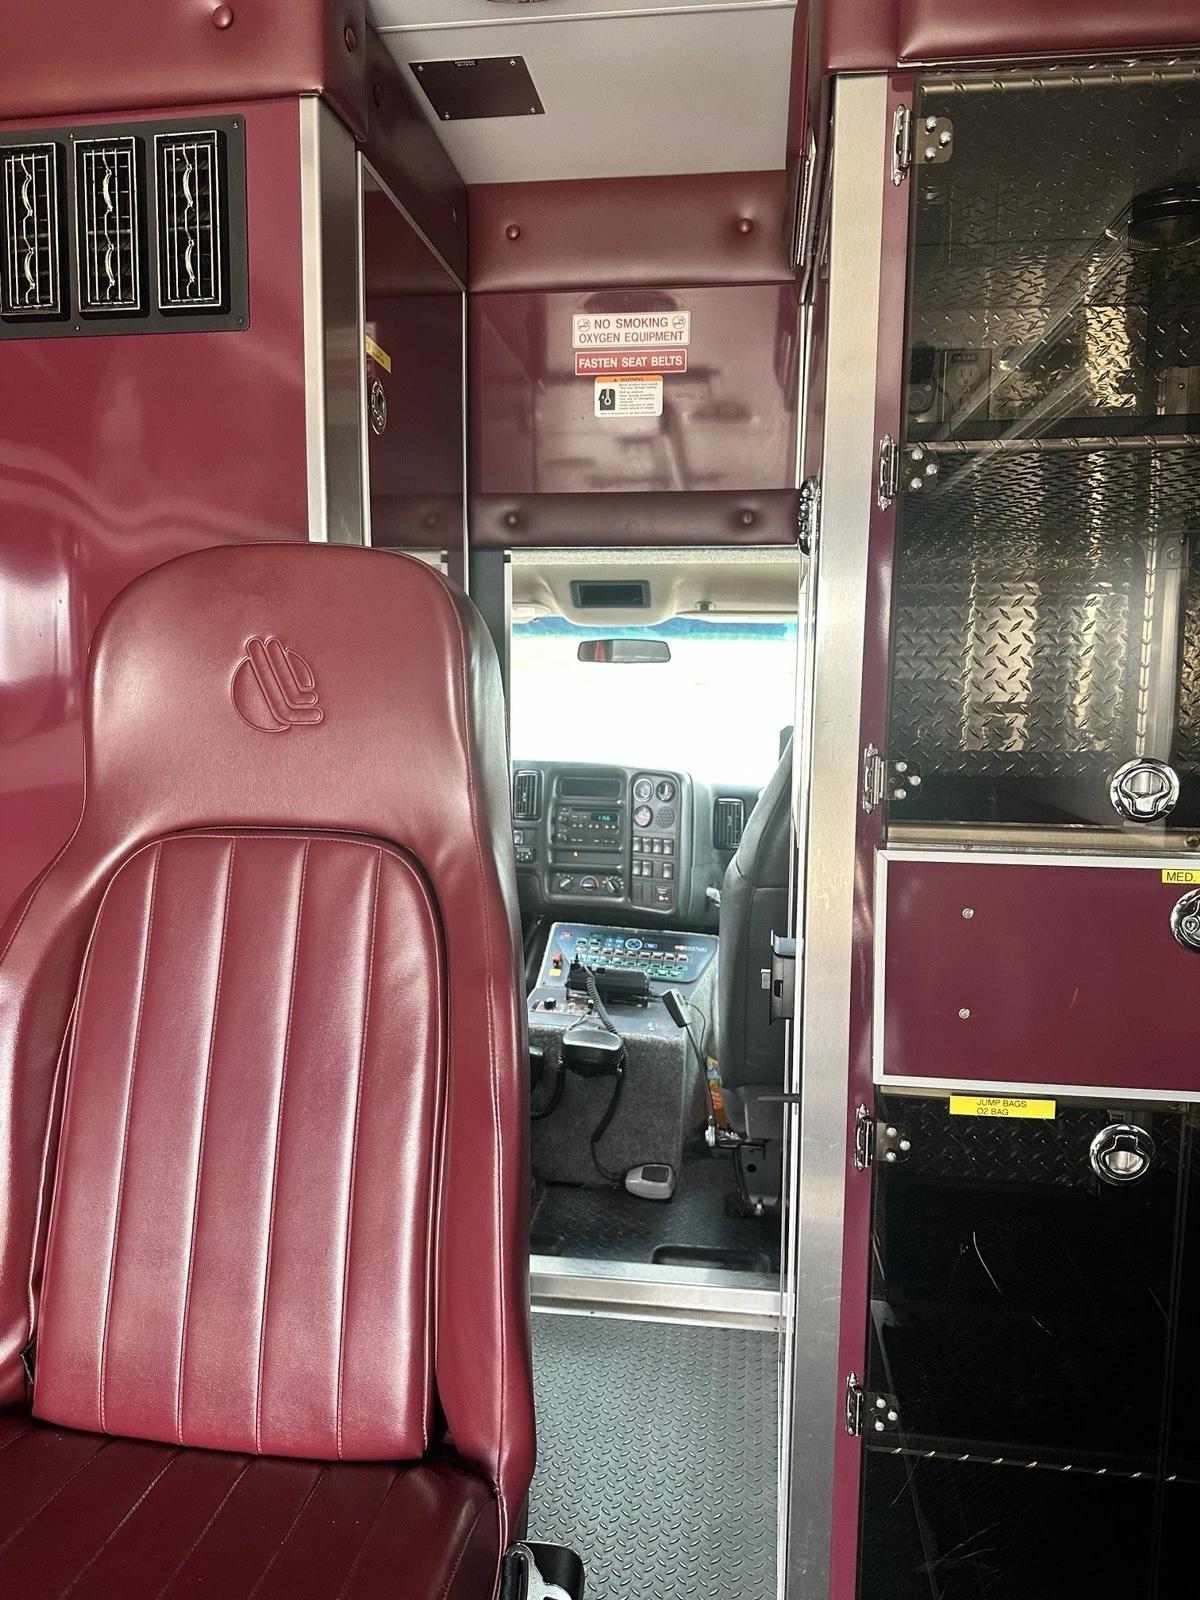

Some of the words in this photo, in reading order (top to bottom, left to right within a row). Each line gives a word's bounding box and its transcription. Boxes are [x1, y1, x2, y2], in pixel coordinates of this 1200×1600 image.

[594, 319, 611, 329] NO
[615, 317, 669, 329] SMOKING
[578, 332, 621, 344] OXYGEN
[624, 330, 685, 343] EQUIPMENT
[578, 358, 618, 369] FASTEN
[621, 356, 648, 368] SEAT
[651, 355, 683, 367] BELTS
[1166, 871, 1196, 882] MED.
[976, 1098, 1001, 1107] JUMP
[1002, 1099, 1028, 1108] BAGS
[976, 1107, 989, 1115] O2
[990, 1108, 1009, 1116] BAG
